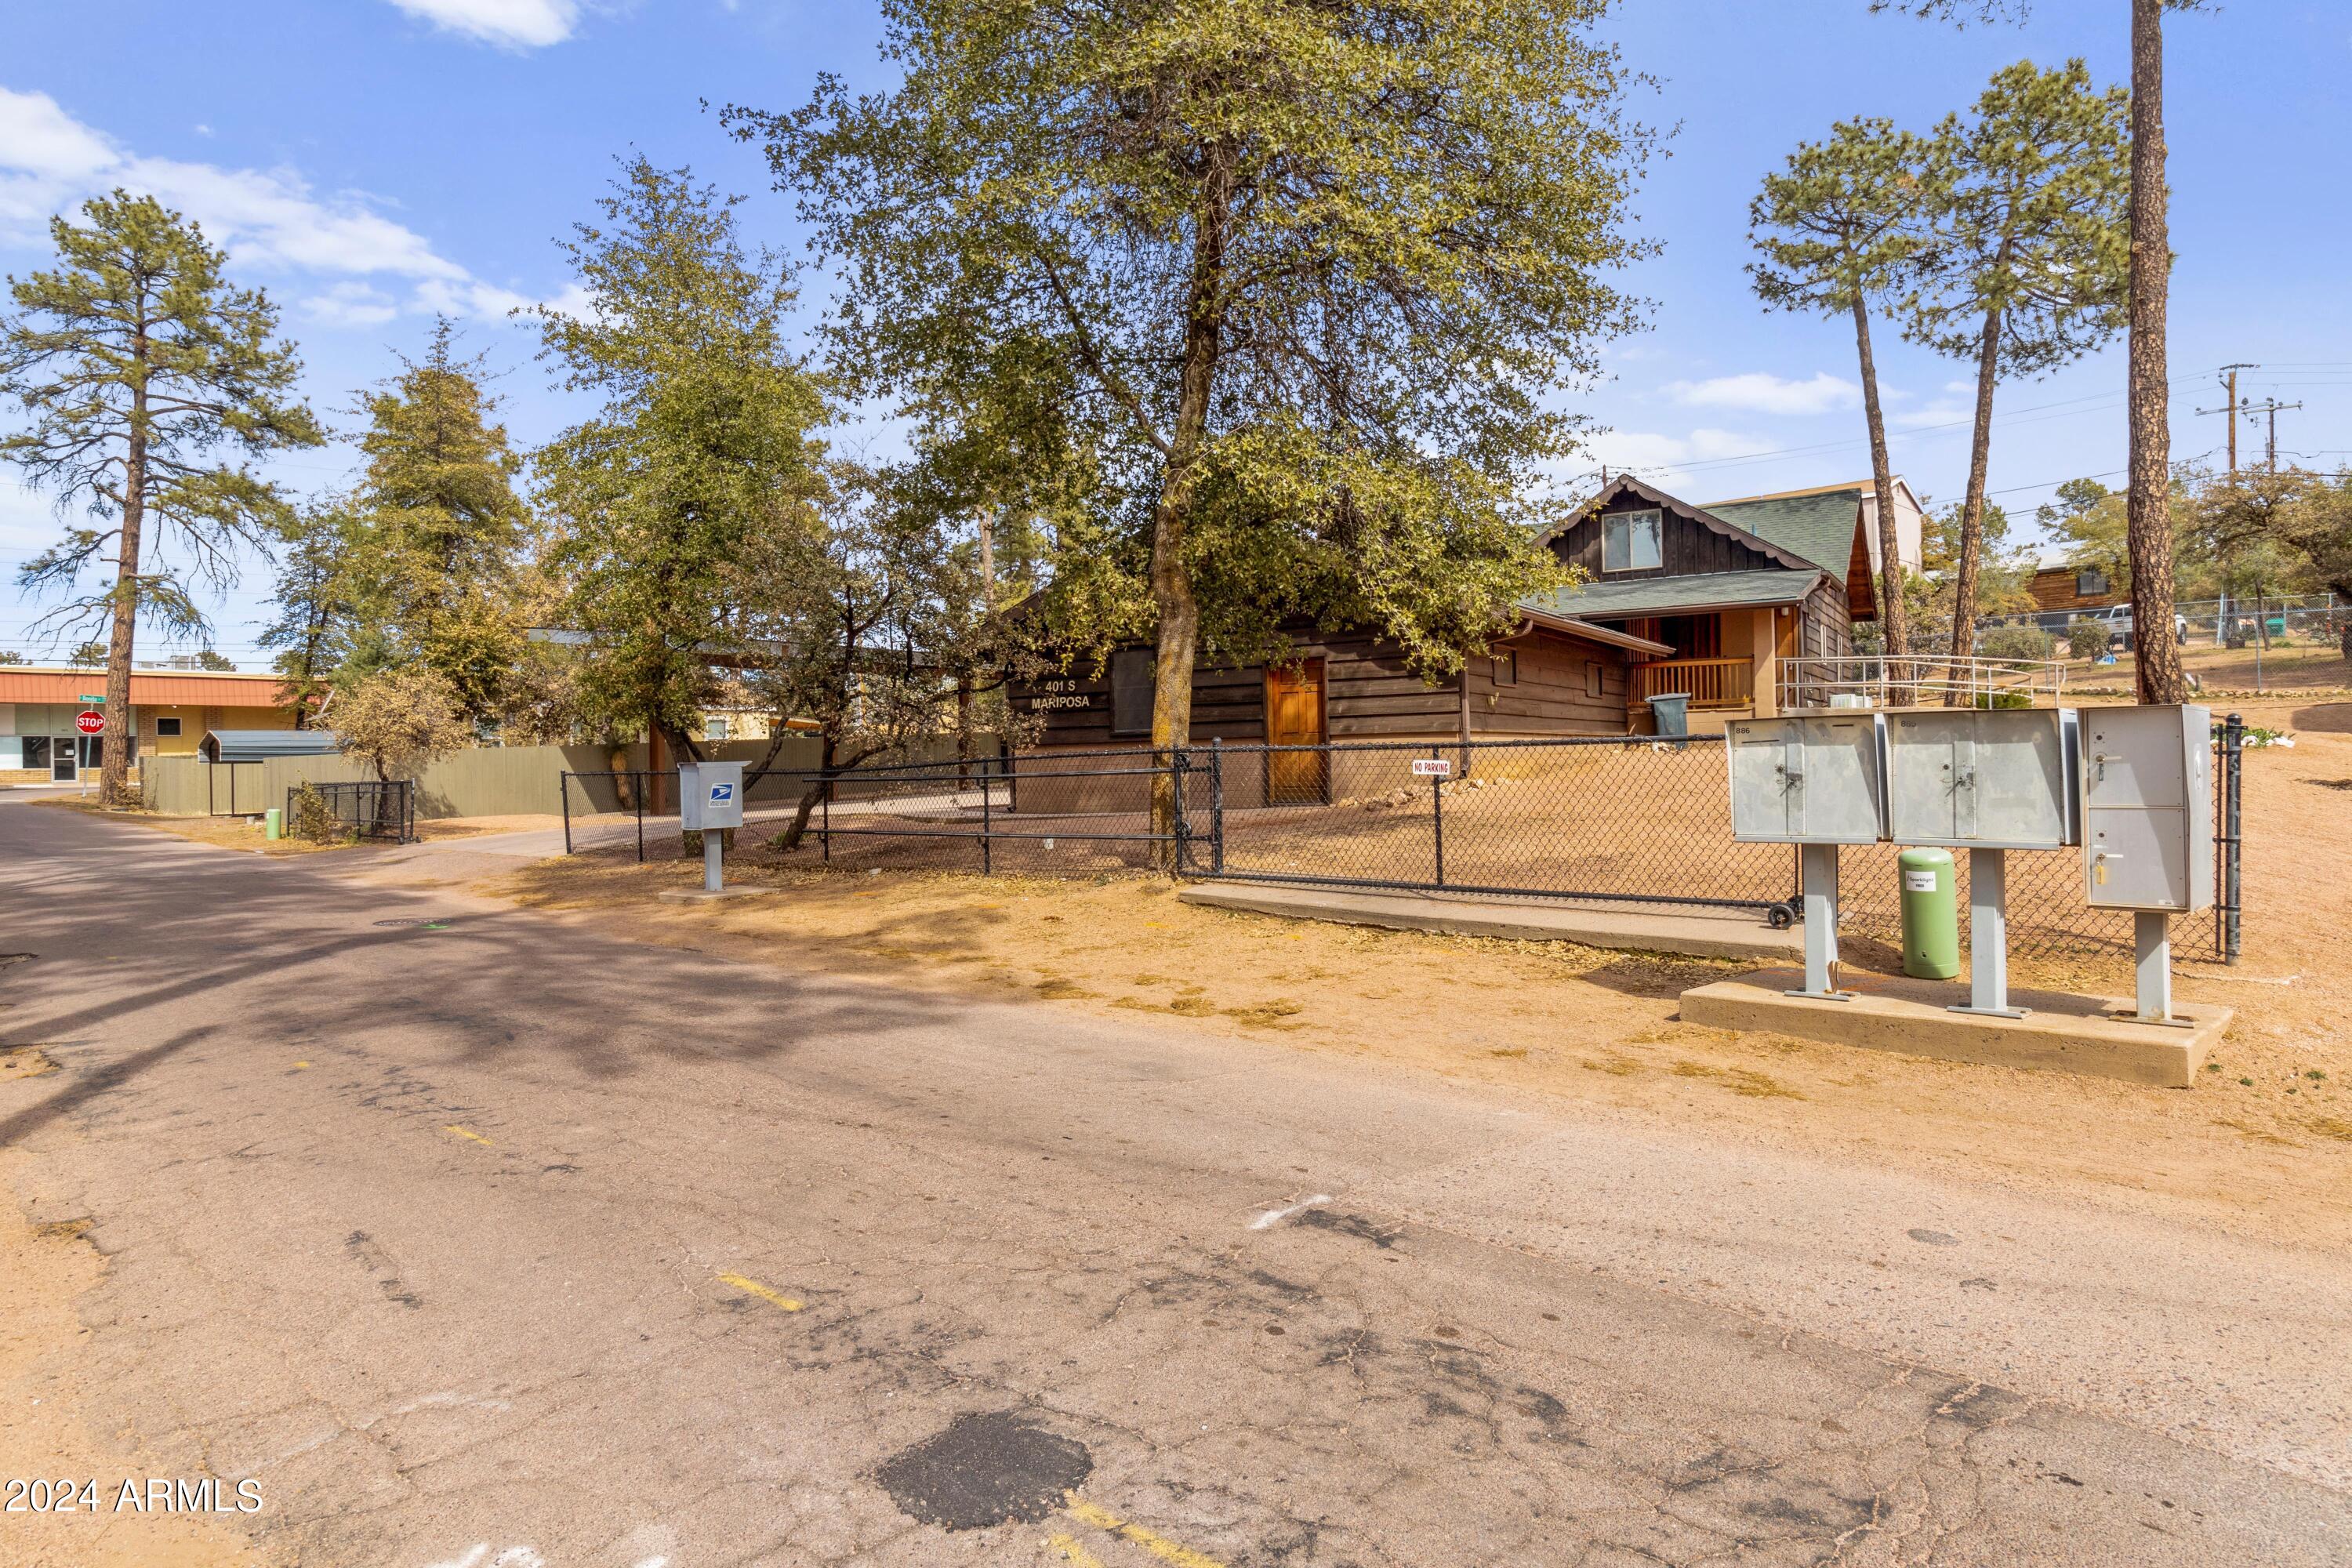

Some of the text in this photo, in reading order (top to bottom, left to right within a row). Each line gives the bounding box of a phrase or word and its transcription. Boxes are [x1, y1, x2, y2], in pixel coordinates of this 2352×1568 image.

[1045, 680, 1076, 692] 401 S
[1032, 695, 1090, 710] MARIPOSA
[78, 717, 103, 728] STOP
[1414, 763, 1448, 773] NO PARKING
